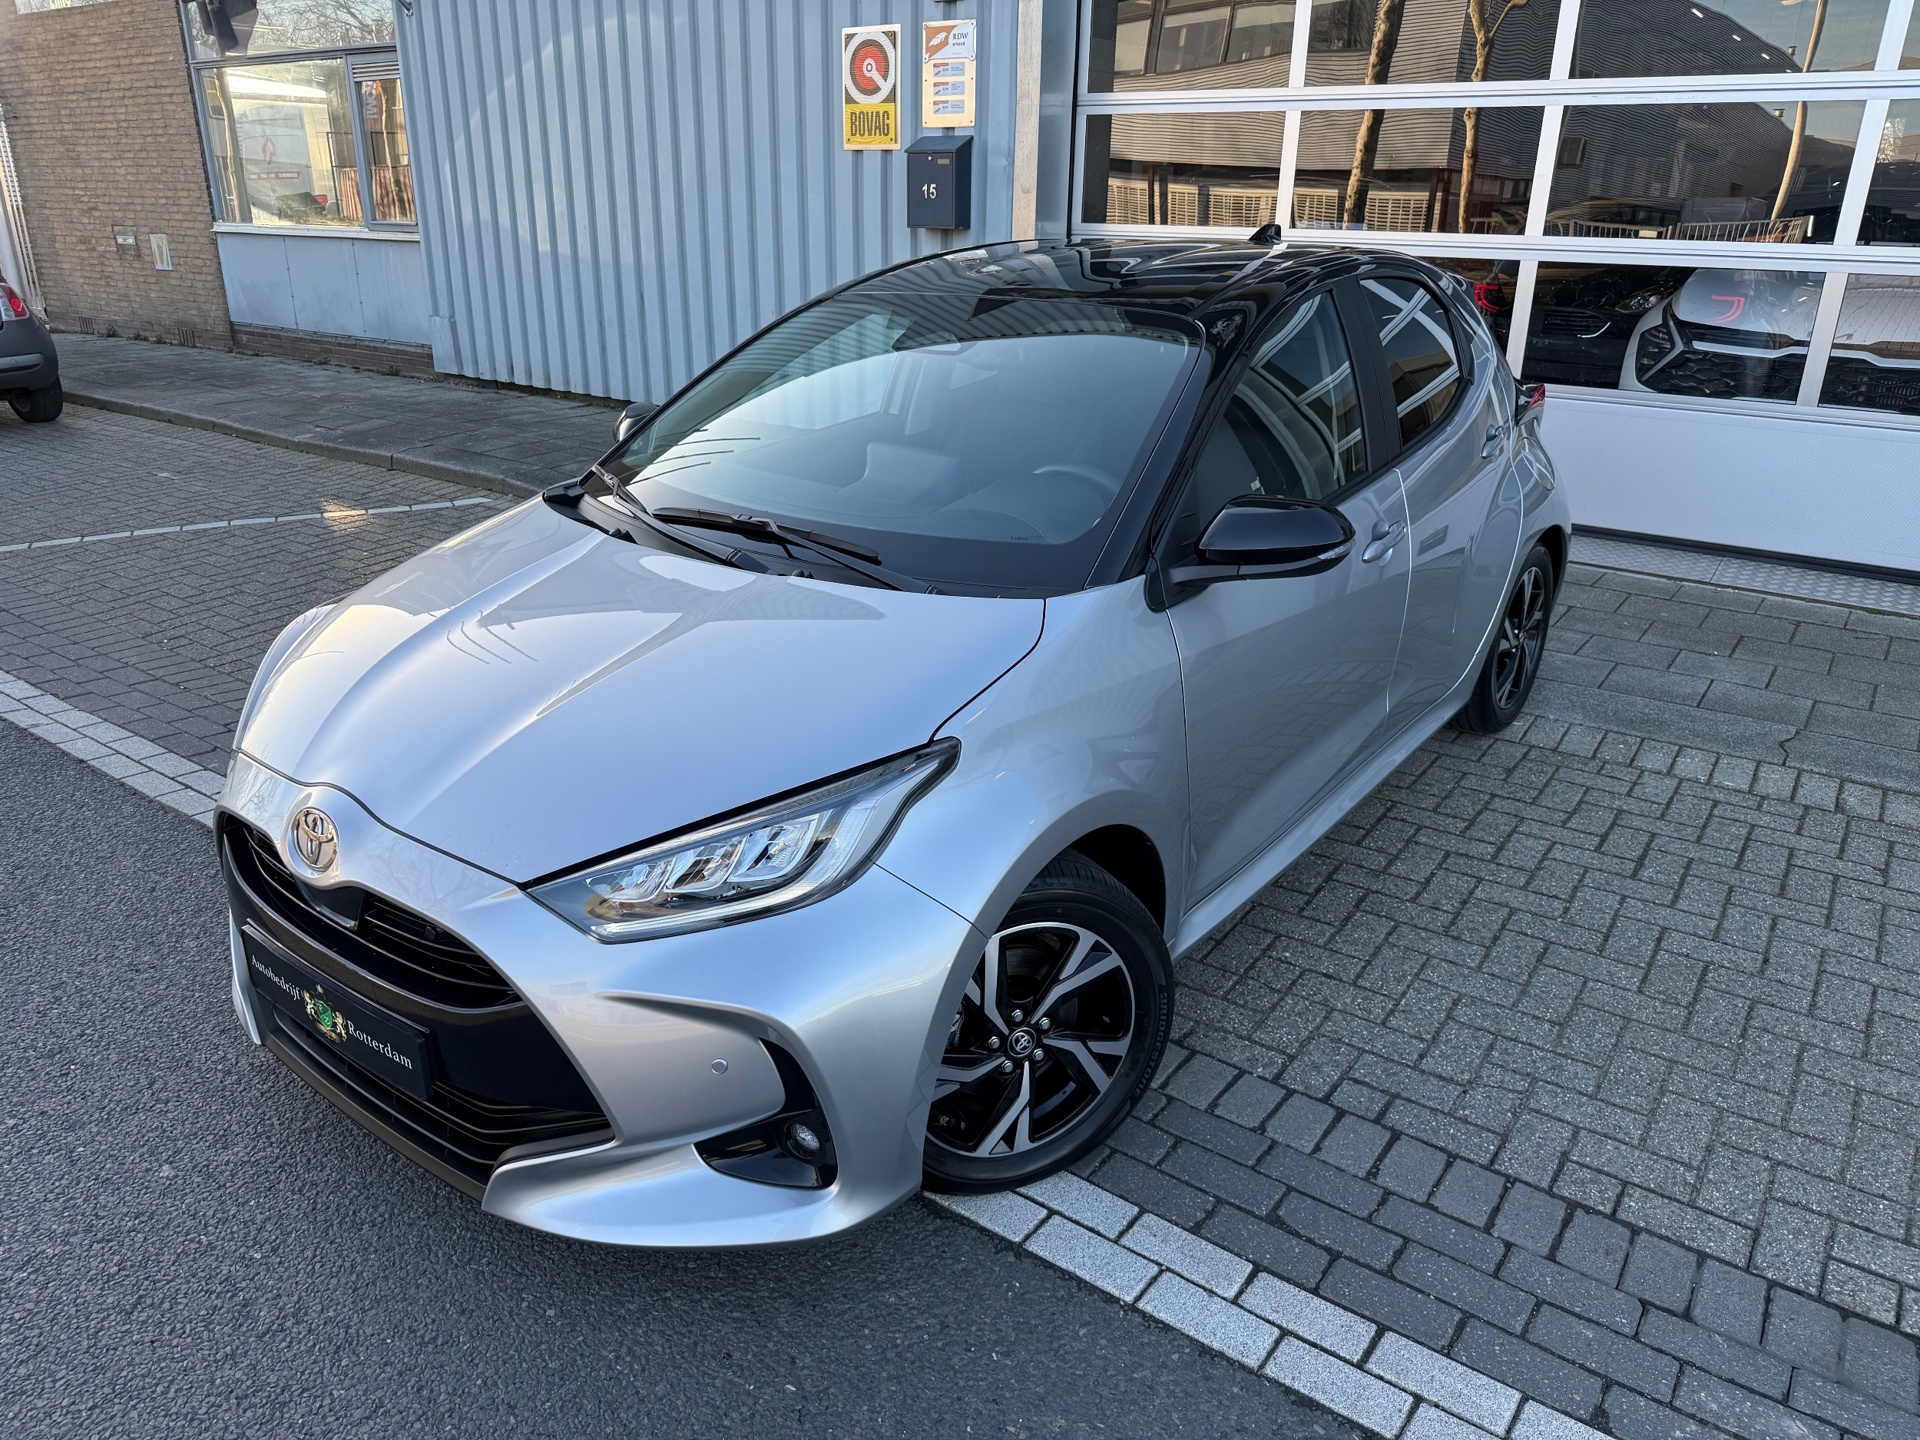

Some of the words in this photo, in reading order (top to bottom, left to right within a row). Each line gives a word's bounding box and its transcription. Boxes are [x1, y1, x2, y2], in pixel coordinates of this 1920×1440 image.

[952, 32, 969, 40] RDW
[849, 110, 890, 137] BOVAG
[922, 183, 937, 199] 15
[252, 954, 302, 1001] Autobedrijf
[347, 1019, 413, 1070] Rotterdam
